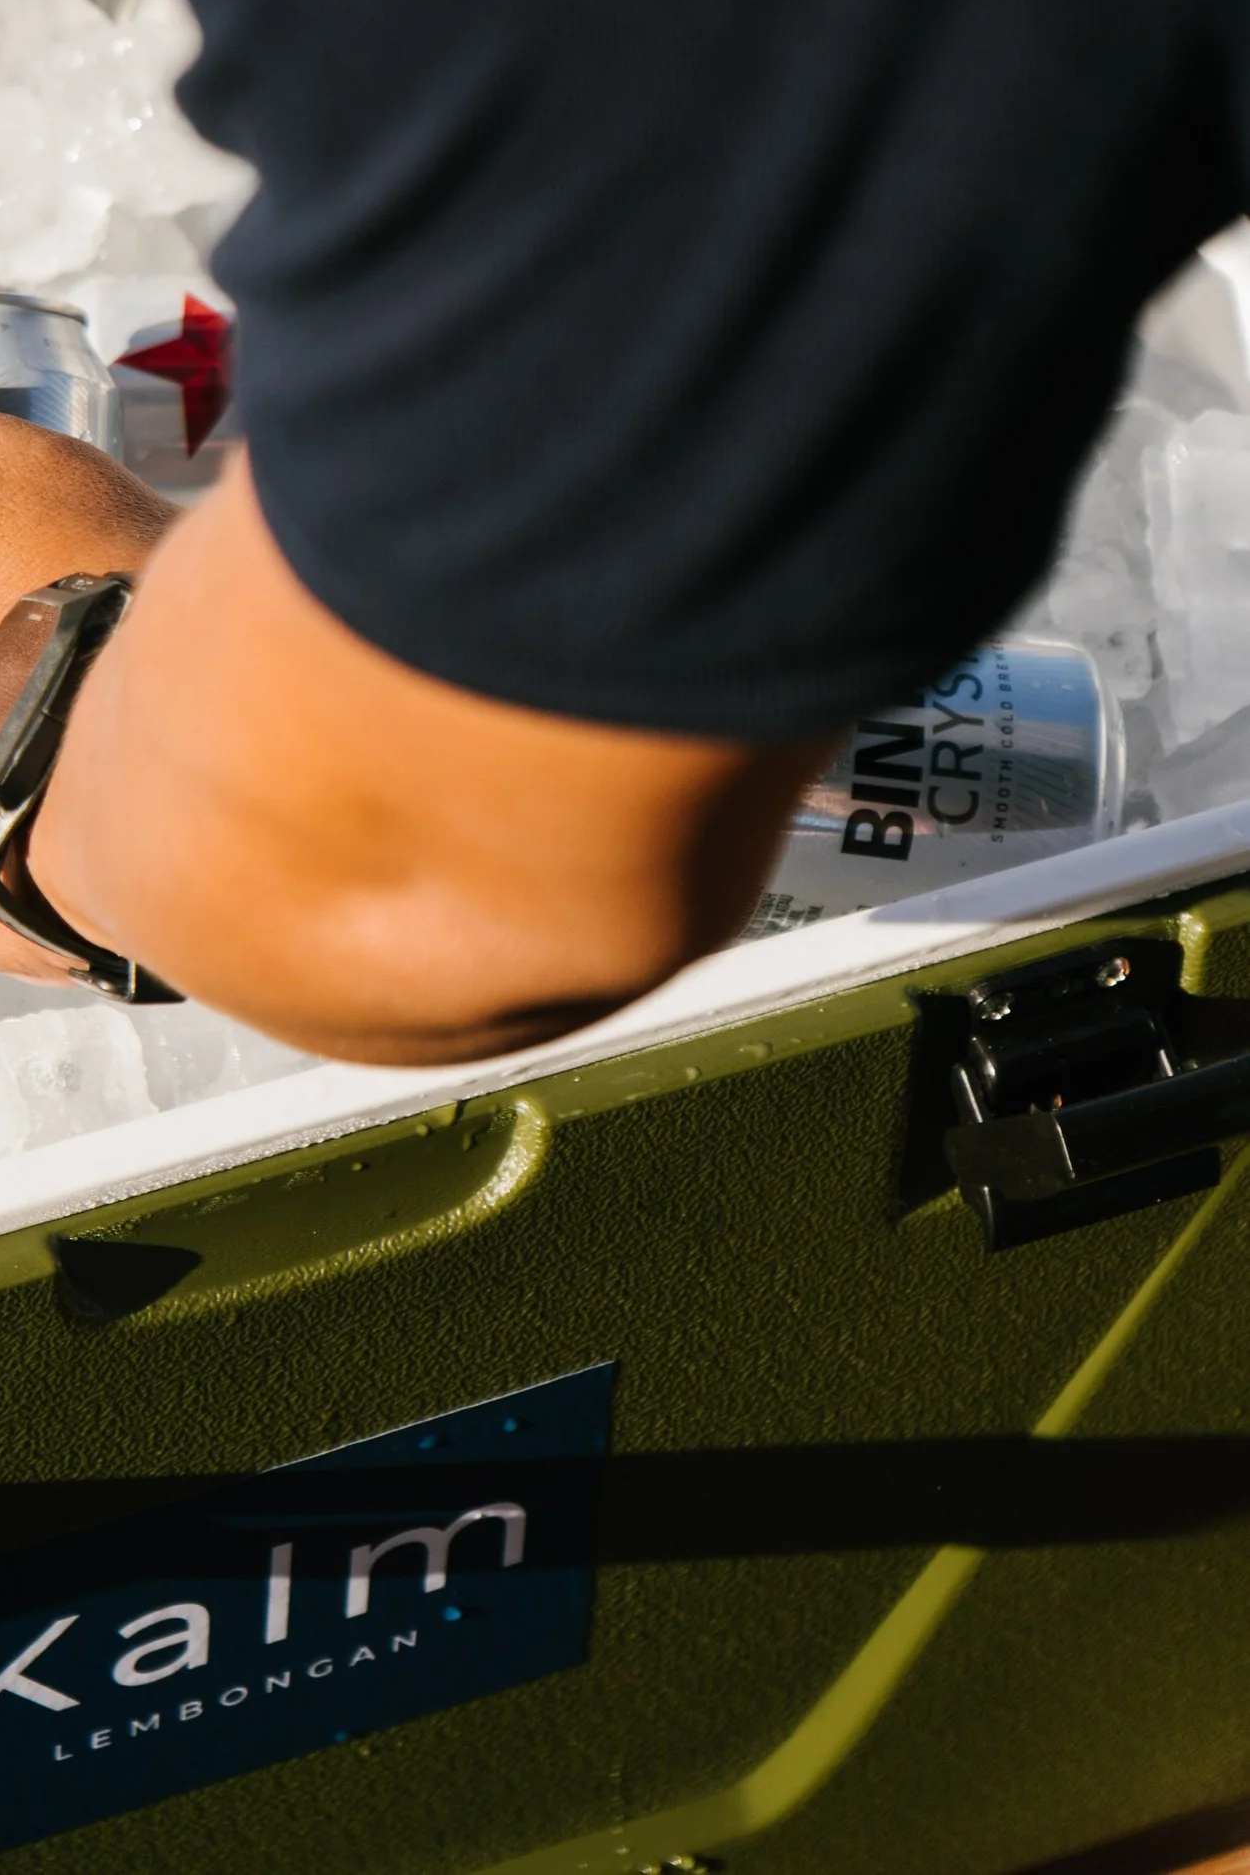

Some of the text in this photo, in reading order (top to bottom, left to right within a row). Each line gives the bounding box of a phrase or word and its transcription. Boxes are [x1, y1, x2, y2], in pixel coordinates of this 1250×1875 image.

[841, 693, 925, 861] BIN
[1000, 701, 1014, 749] COLD
[992, 760, 1013, 843] SMOOTH
[54, 1630, 419, 1762] LEMBONGAN
